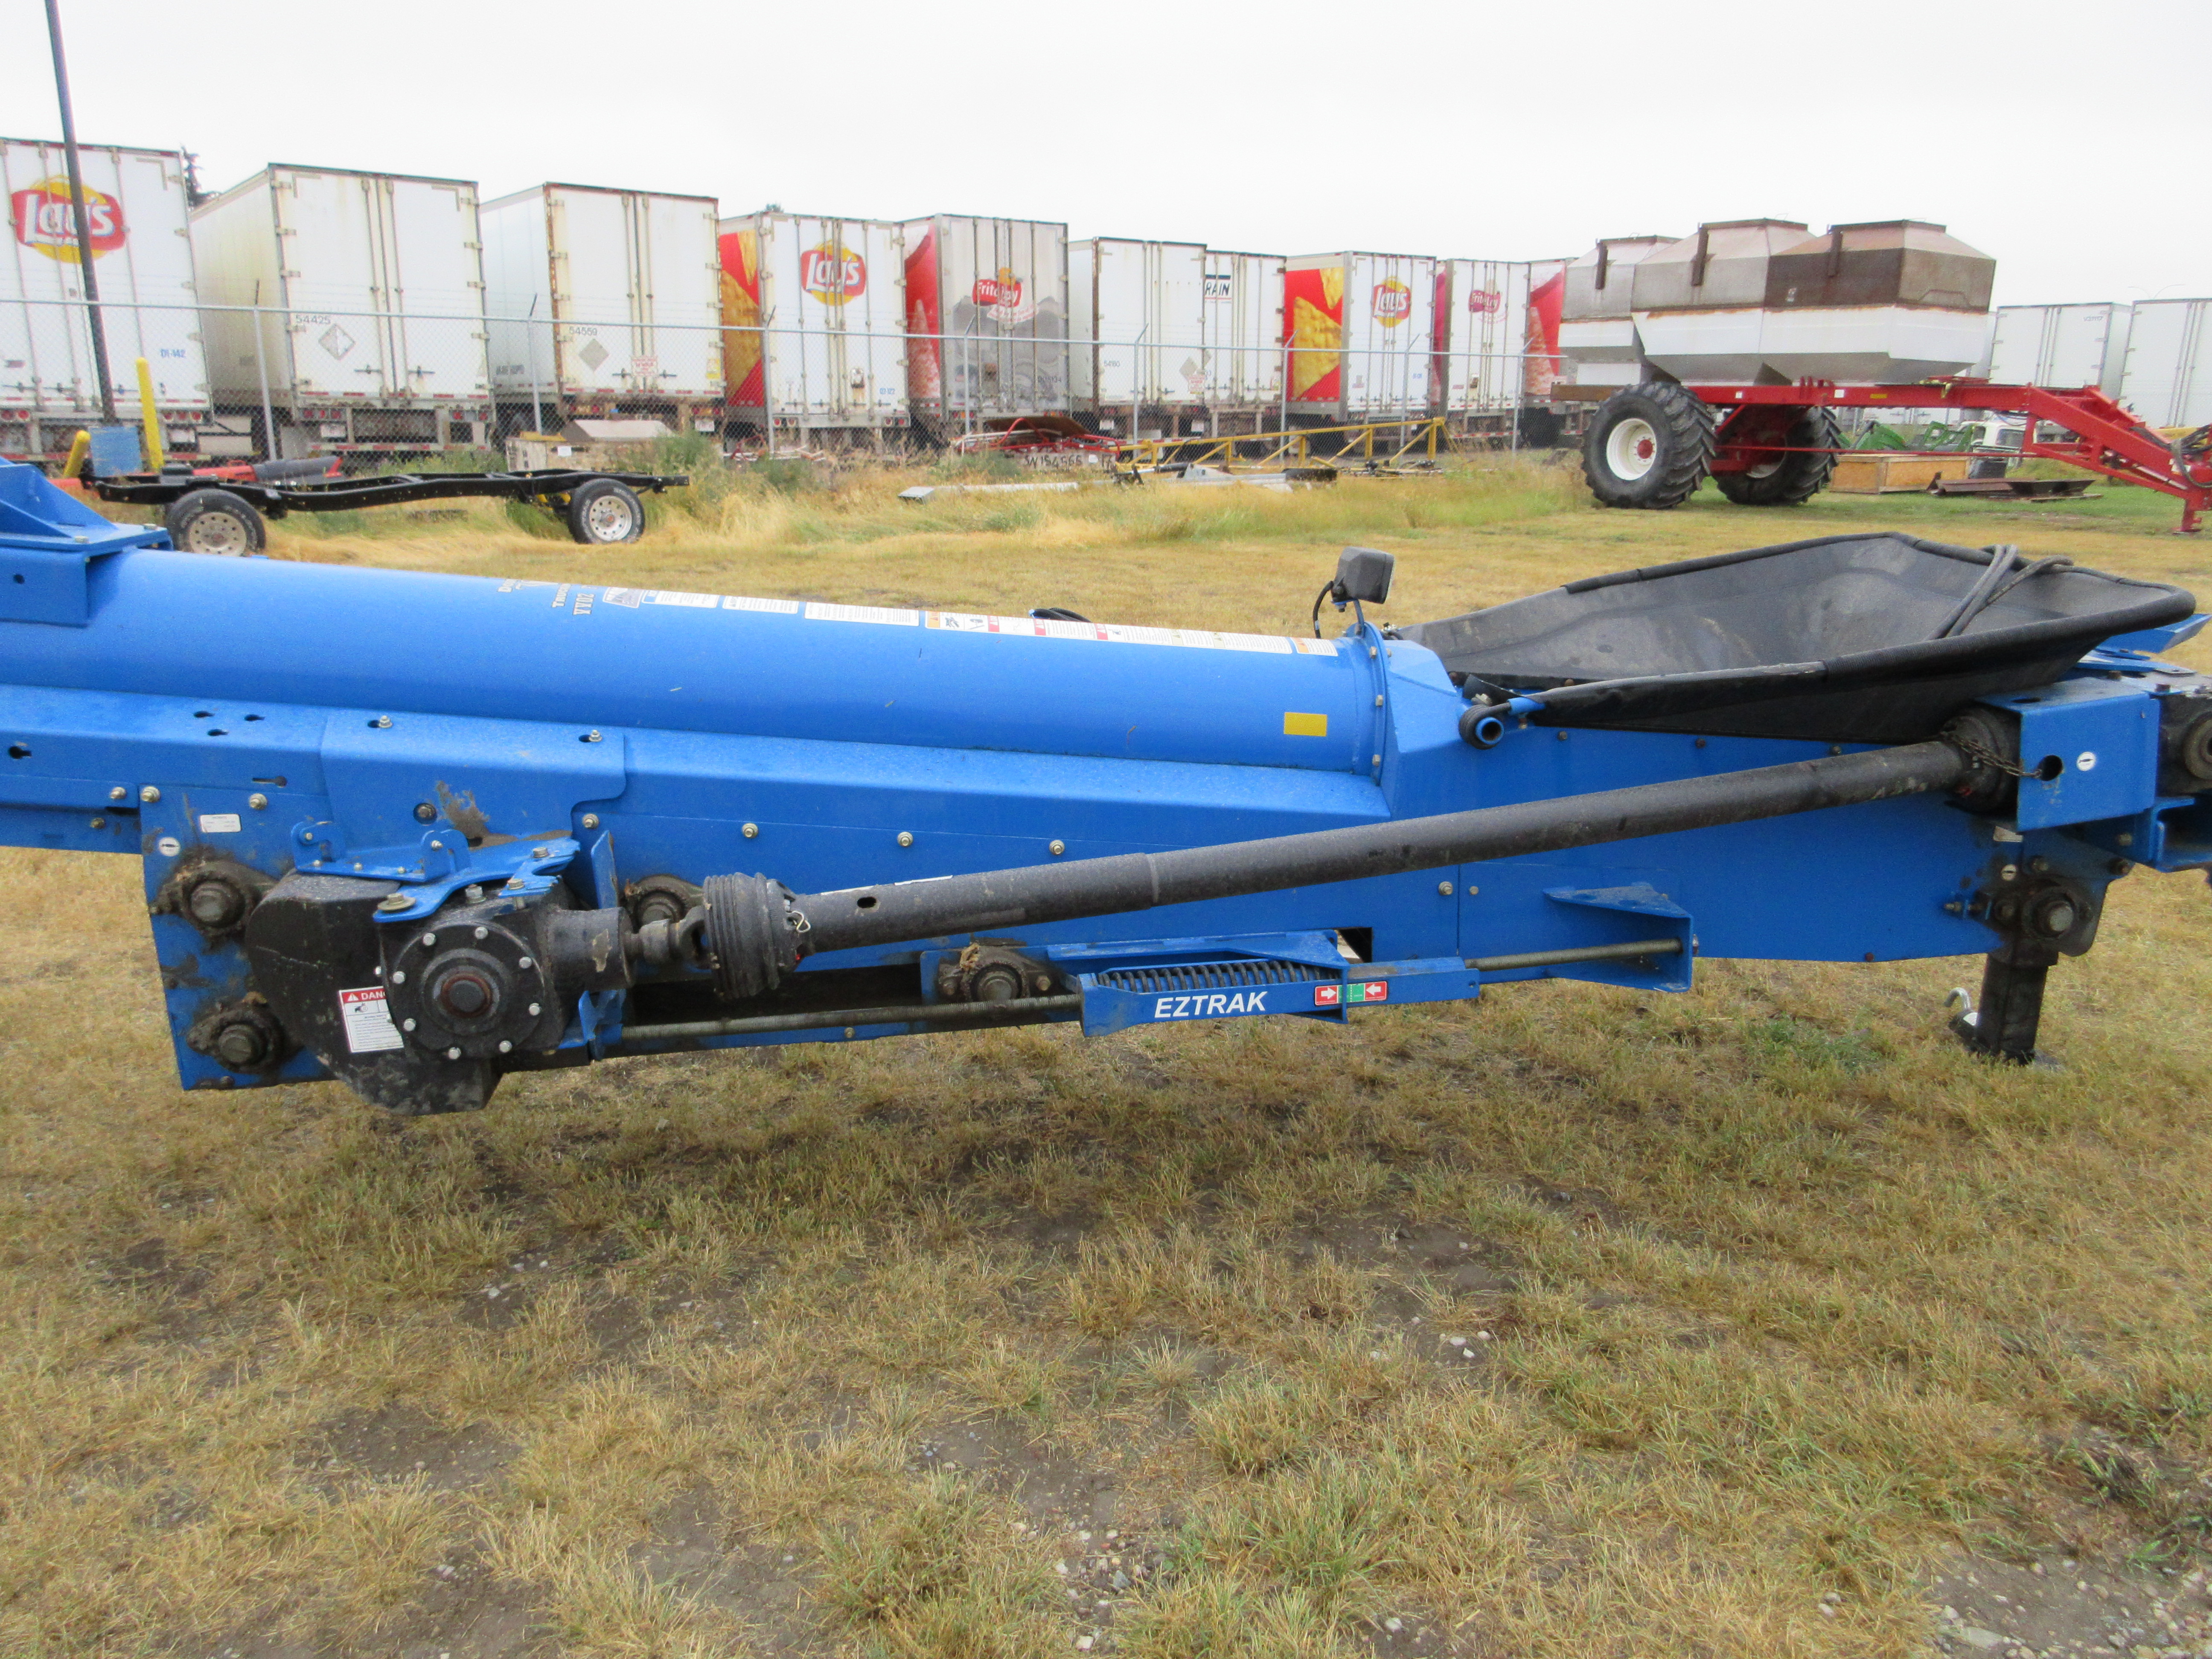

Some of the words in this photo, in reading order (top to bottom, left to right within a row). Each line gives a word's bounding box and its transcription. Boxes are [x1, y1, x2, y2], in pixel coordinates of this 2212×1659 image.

[805, 253, 861, 294] Lay's
[1374, 287, 1408, 317] Lay's
[1154, 991, 1268, 1019] EZTRAK
